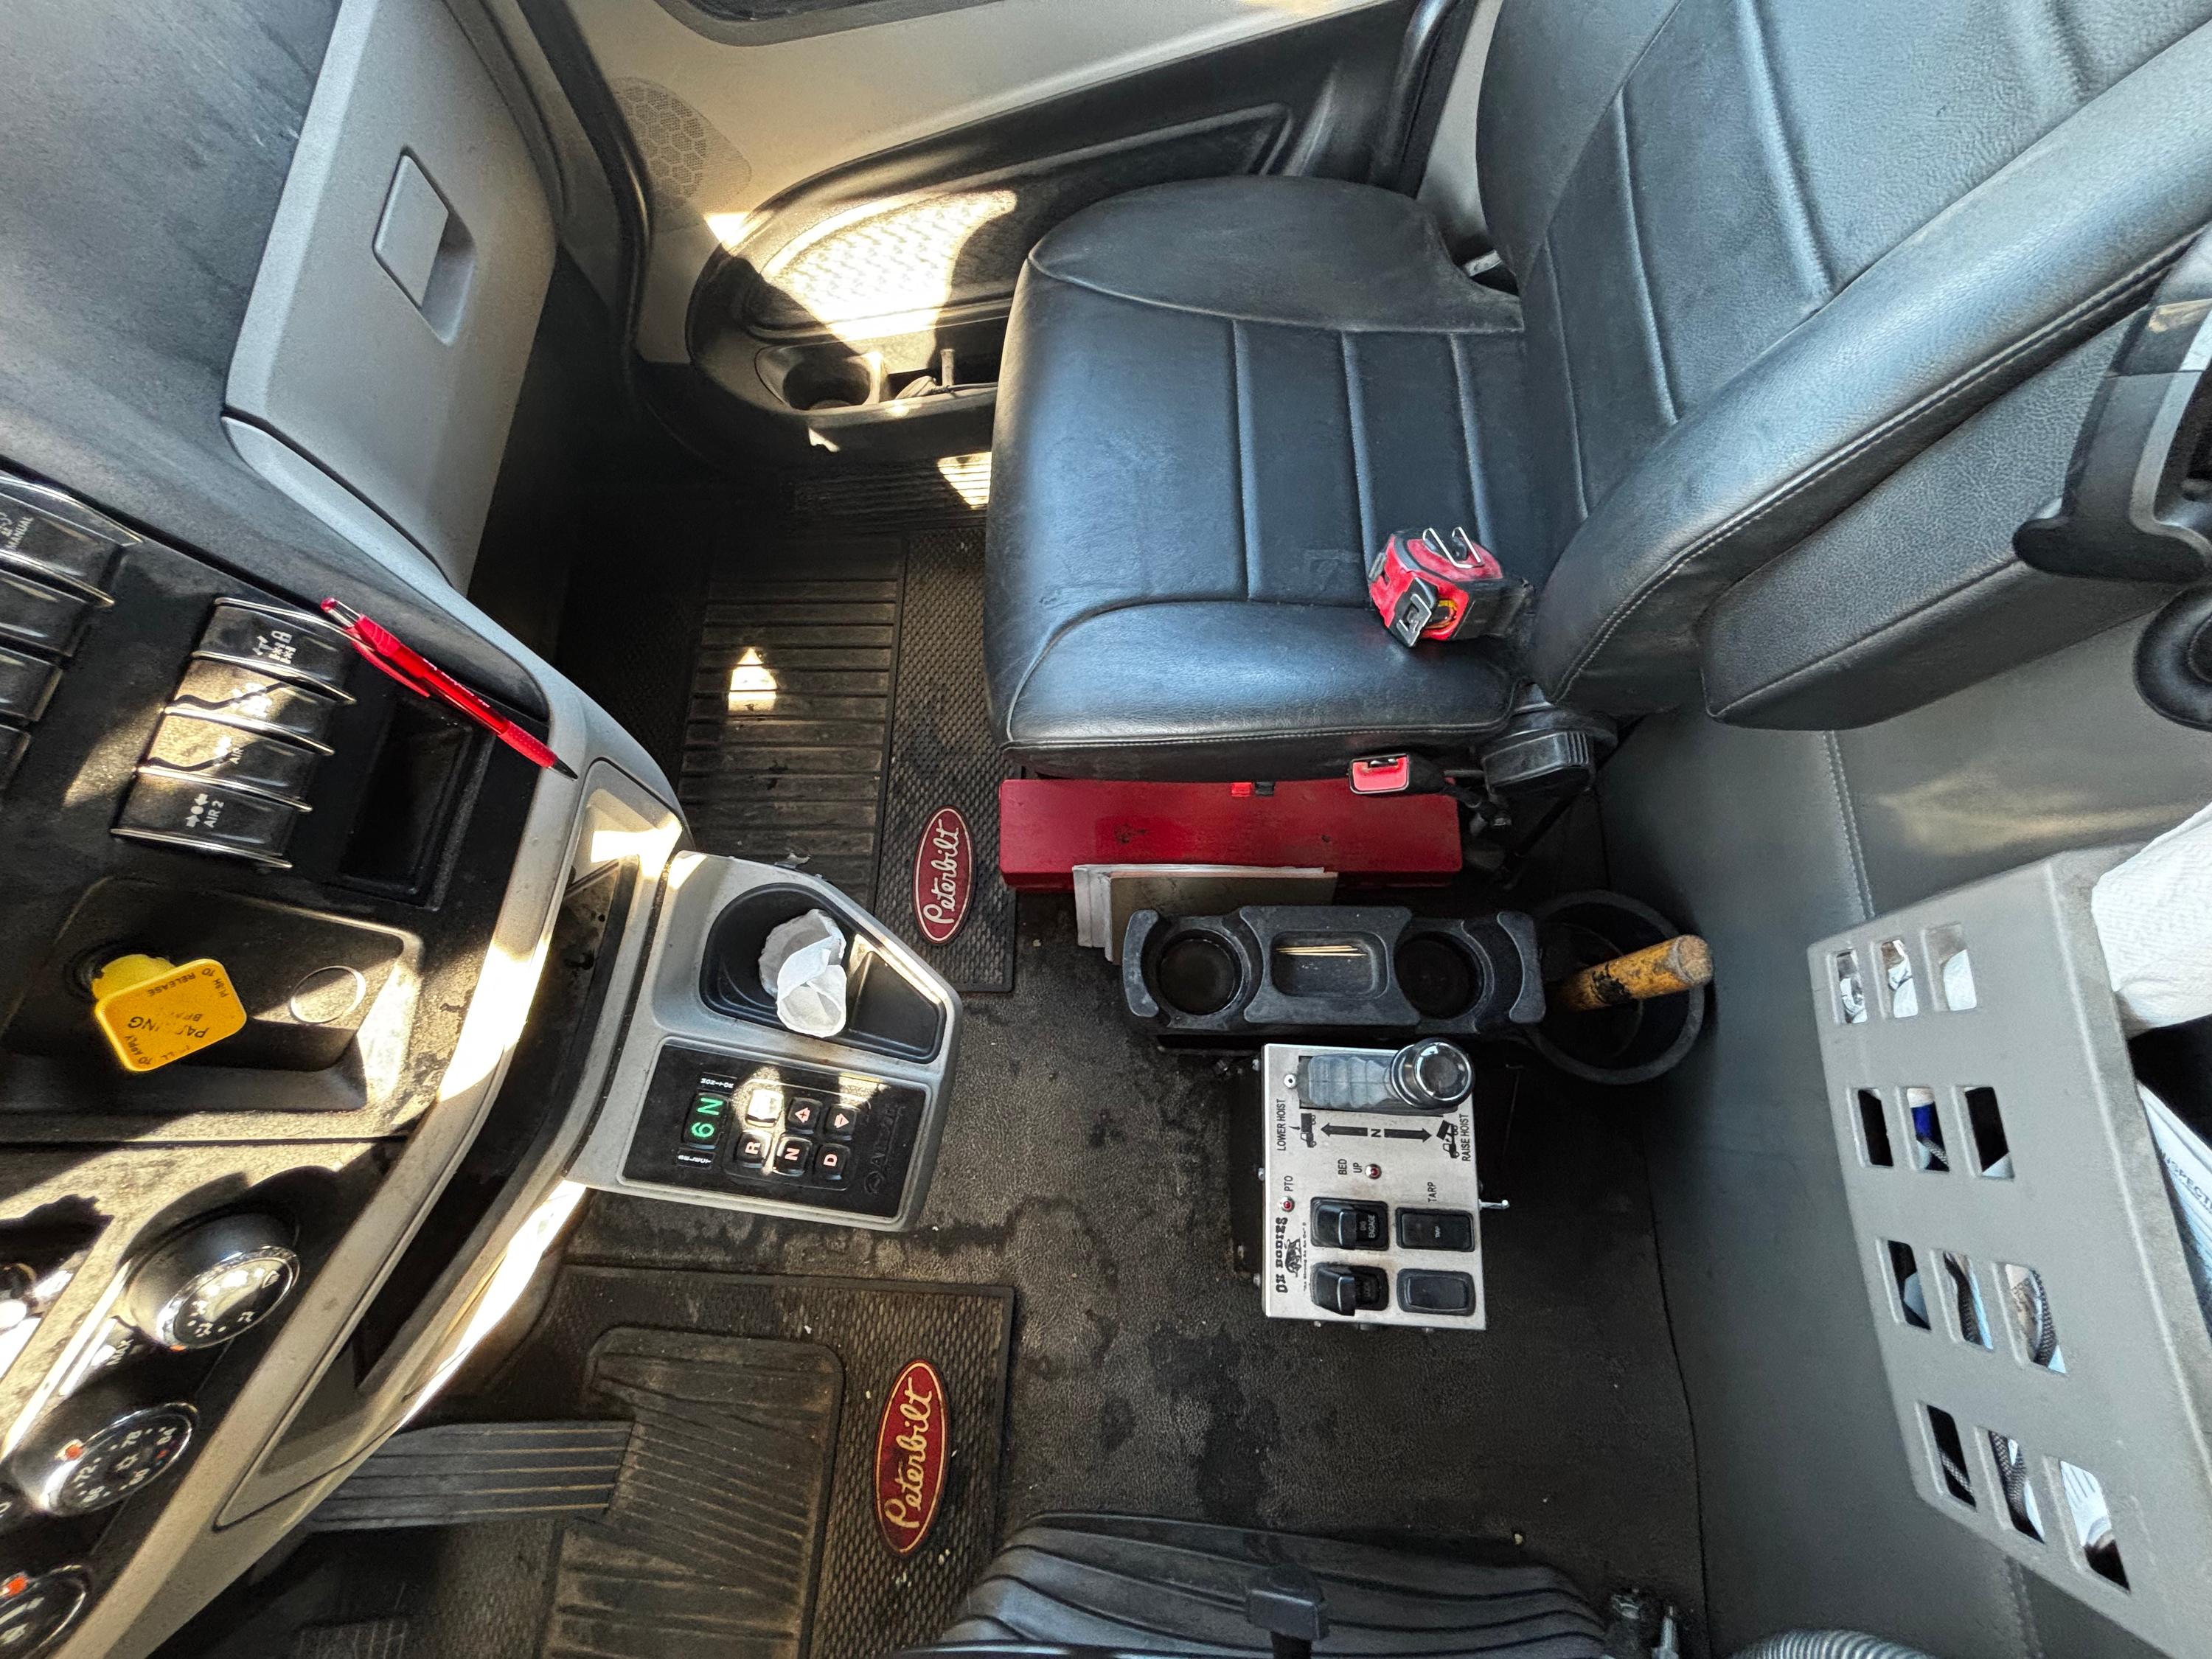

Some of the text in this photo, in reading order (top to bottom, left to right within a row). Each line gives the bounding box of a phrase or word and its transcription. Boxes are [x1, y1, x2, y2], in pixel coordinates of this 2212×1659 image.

[5, 516, 35, 549] MANUAL
[204, 800, 224, 828] AIR 2
[922, 818, 959, 925] Peterbilt
[201, 967, 216, 977] TO
[147, 973, 196, 997] RELEASE
[125, 1034, 143, 1056] APPLY
[700, 1077, 735, 1088] MONITOR
[691, 1097, 723, 1138] 6 N
[1276, 1099, 1287, 1151] LOWER HOIST
[1371, 1128, 1382, 1138] N
[1458, 1113, 1471, 1161] RAISE HOIST
[745, 1141, 761, 1155] R
[785, 1147, 800, 1161] N
[678, 1154, 712, 1164] SELECT
[823, 1153, 838, 1167] D
[1338, 1158, 1348, 1175] BED
[1352, 1162, 1363, 1173] UP
[1284, 1175, 1293, 1192] PTO
[1427, 1182, 1437, 1203] TARP
[1368, 1214, 1376, 1239] ENGAGE
[1276, 1217, 1288, 1268] BODIES
[884, 1377, 933, 1528] Peterbilt
[74, 1464, 98, 1482] 72
